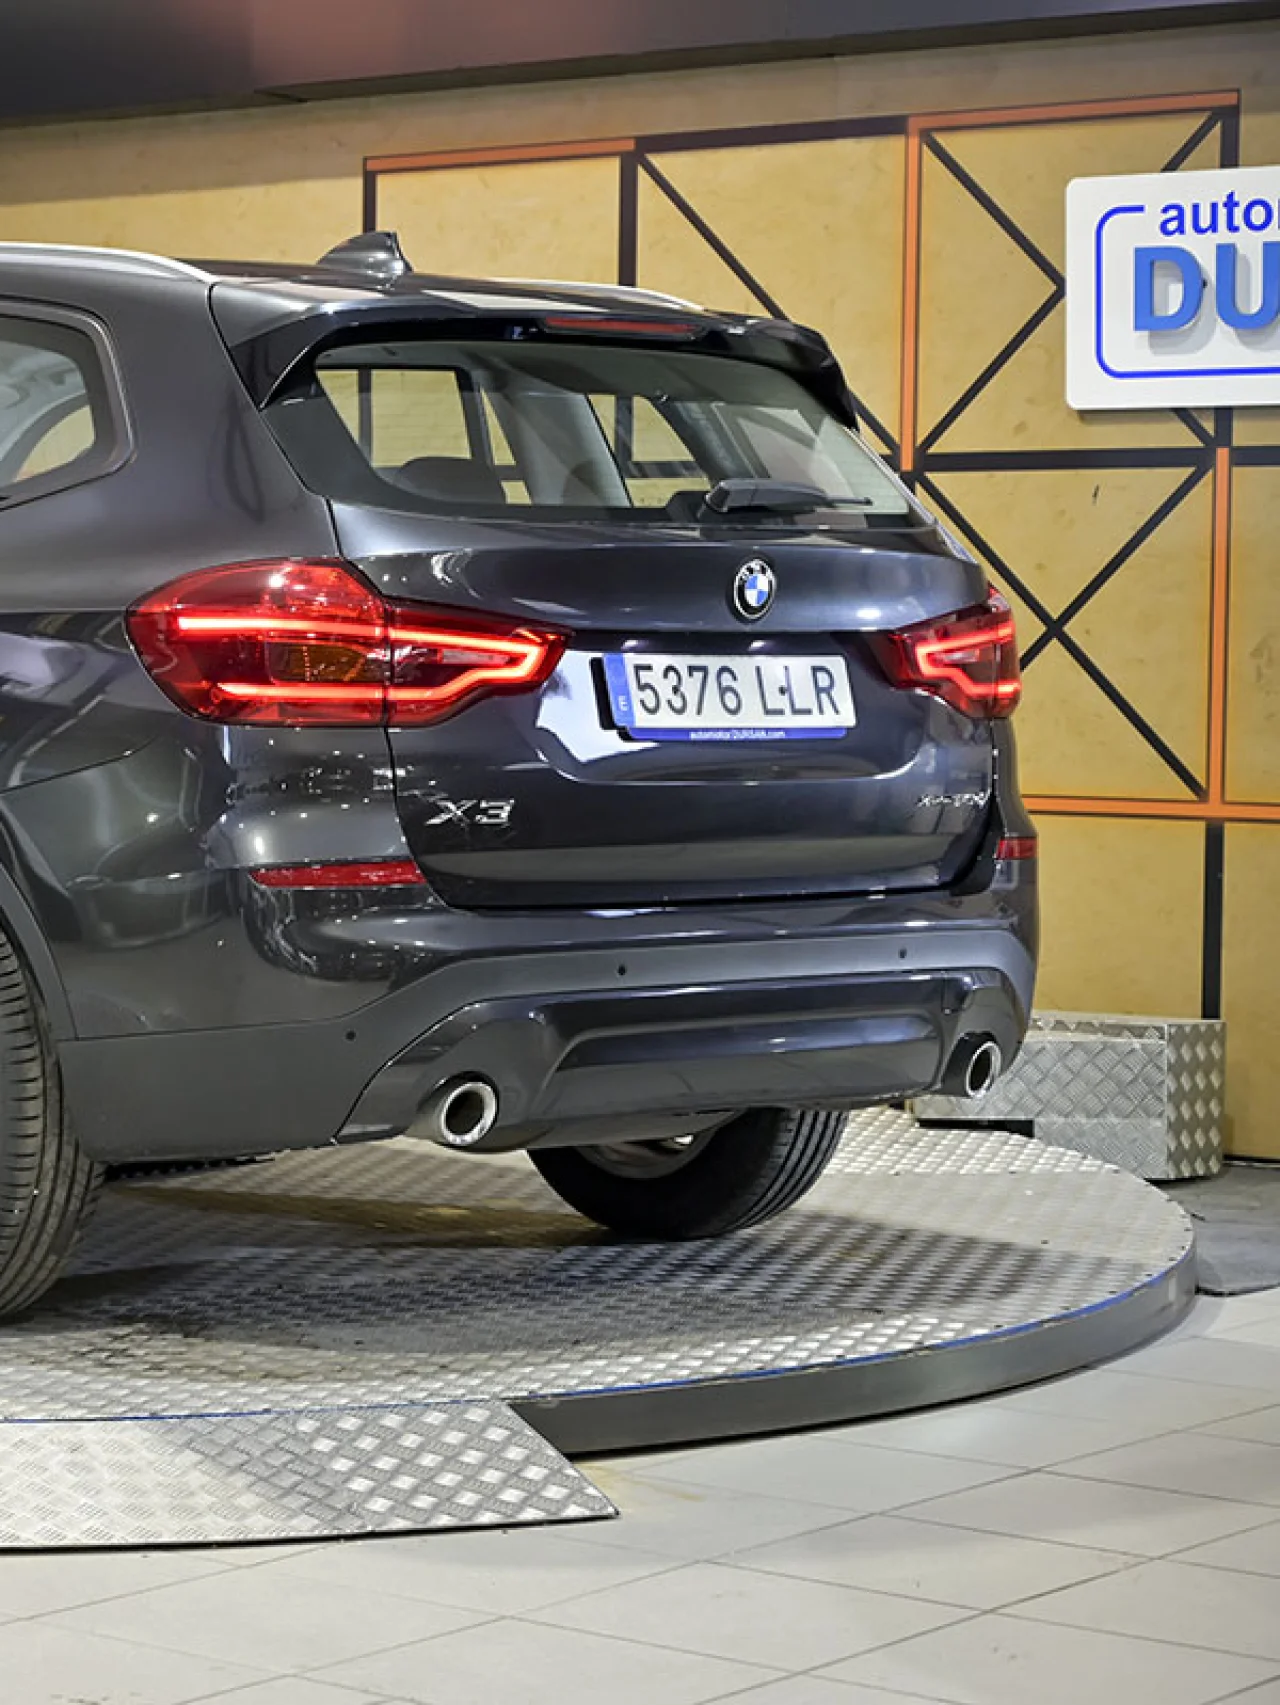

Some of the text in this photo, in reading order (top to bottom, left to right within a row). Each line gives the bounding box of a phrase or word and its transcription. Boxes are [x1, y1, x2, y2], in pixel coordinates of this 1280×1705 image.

[1159, 191, 1280, 236] auto
[1133, 241, 1280, 331] DU
[618, 697, 629, 713] E
[633, 663, 841, 716] 5376 LLR
[424, 798, 515, 826] X3
